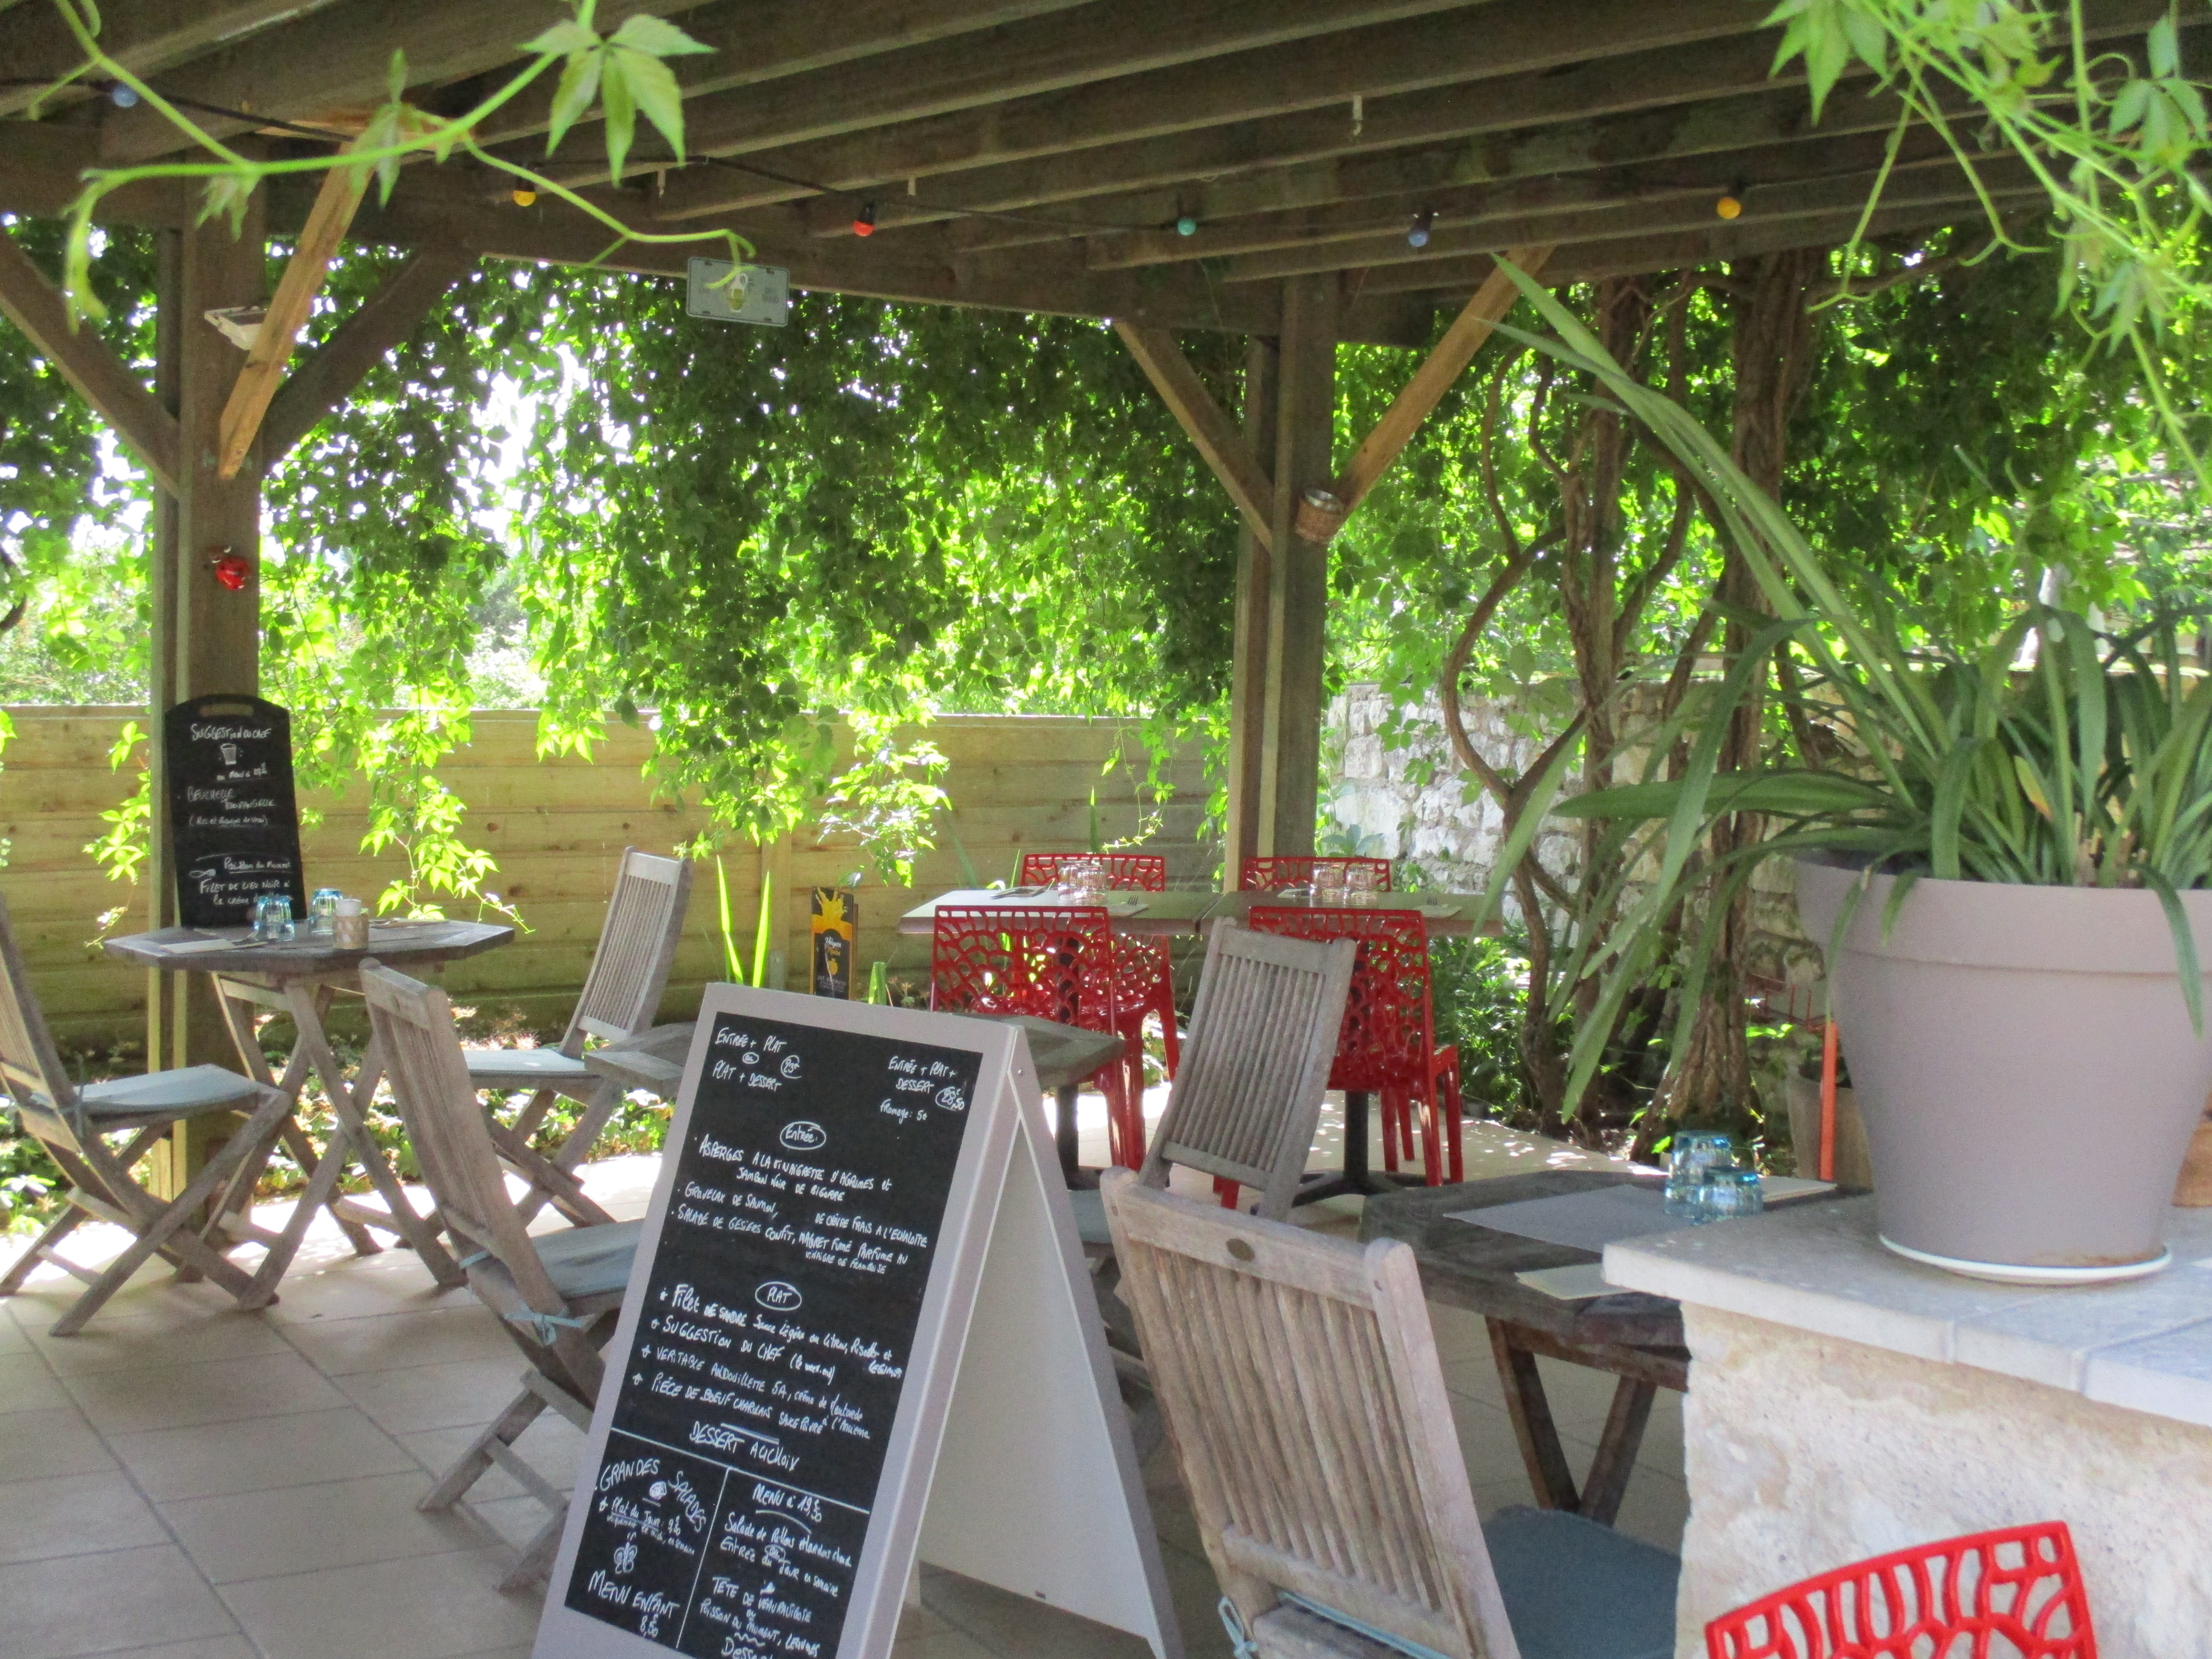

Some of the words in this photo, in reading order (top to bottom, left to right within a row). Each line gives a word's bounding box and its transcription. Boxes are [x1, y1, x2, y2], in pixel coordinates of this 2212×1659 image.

[763, 1035, 787, 1053] PLAT
[712, 1060, 737, 1079] PLAT
[747, 1073, 782, 1091] DESSERT
[930, 1061, 949, 1077] PLAT
[896, 1078, 935, 1094] DESSERT
[699, 1133, 744, 1161] ASPERGES
[795, 1184, 806, 1194] DE
[678, 1203, 710, 1226] SALADE
[713, 1216, 724, 1229] DE
[732, 1194, 743, 1206] DE
[815, 1213, 826, 1224] DE
[767, 1286, 793, 1304] PLAT
[663, 1315, 732, 1349] SUGGESTION
[741, 1339, 753, 1353] DU
[757, 1343, 785, 1361] CHEF
[685, 1386, 701, 1399] DE
[689, 1421, 745, 1453] DESSERT
[600, 1458, 660, 1492] GRANDES
[752, 1483, 785, 1506] MENU
[588, 1569, 632, 1605] MENU
[632, 1591, 680, 1618] ENFANT
